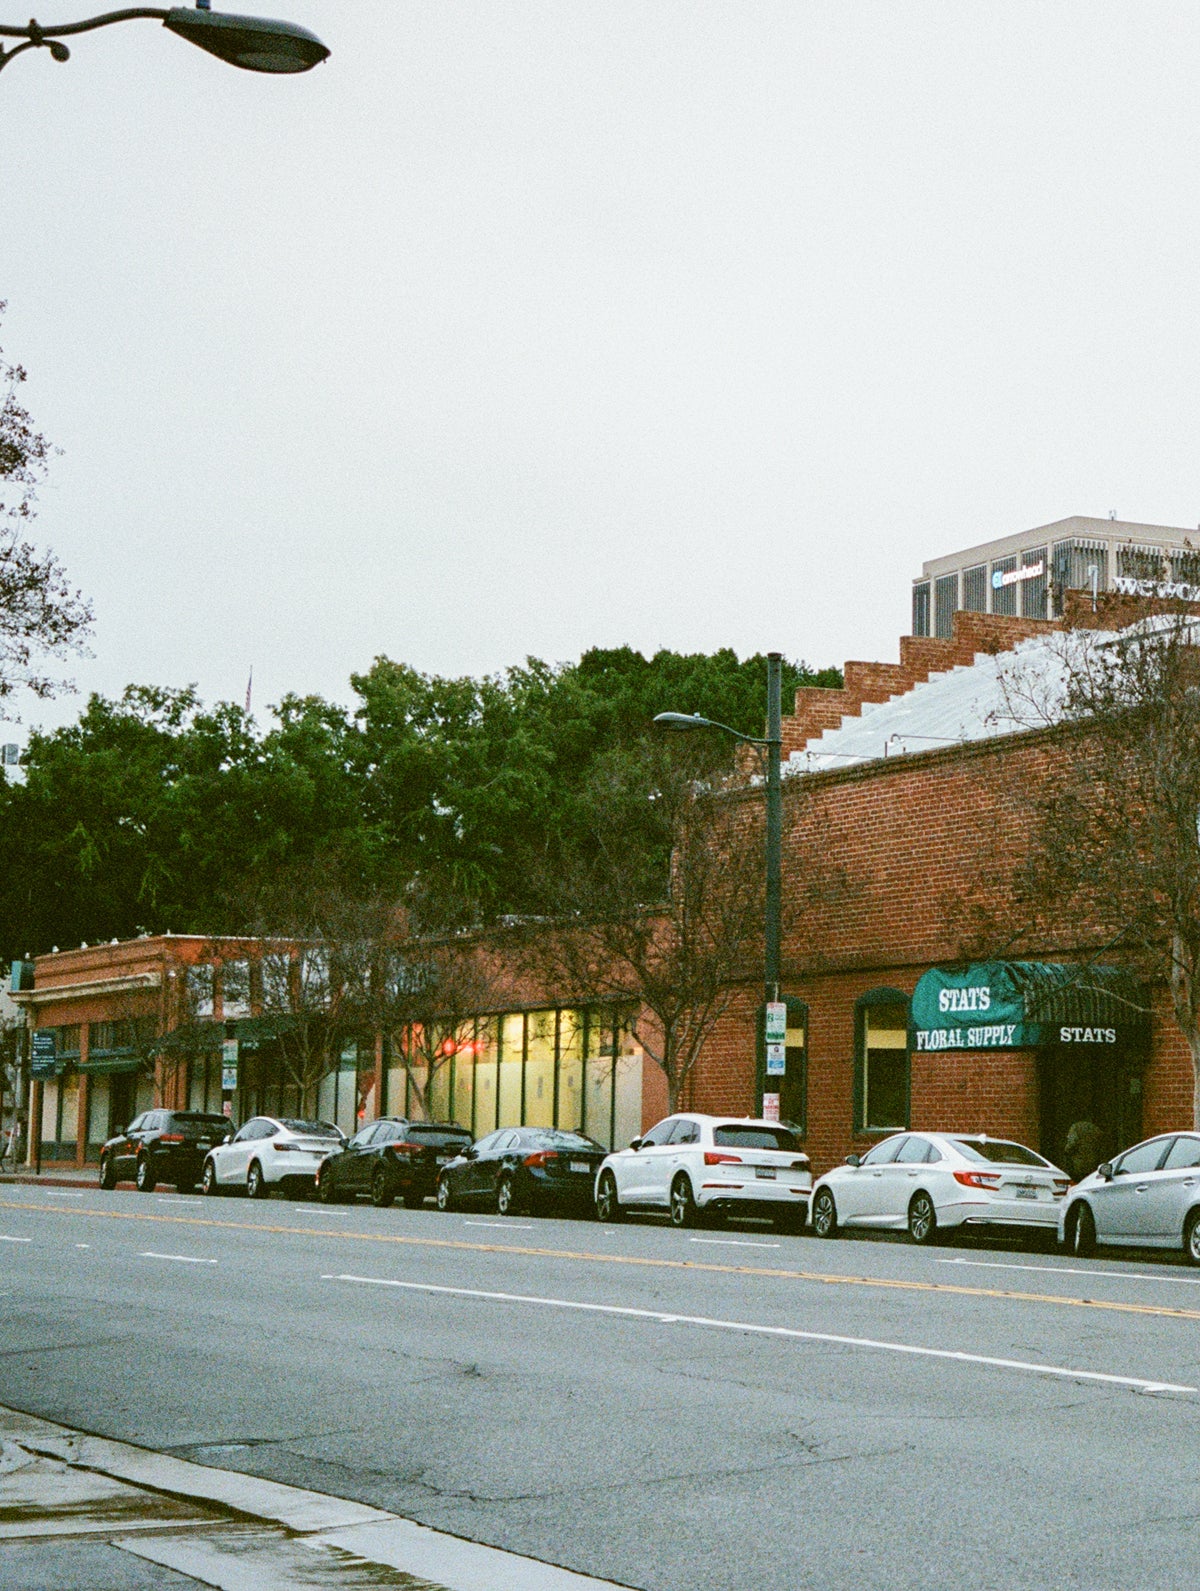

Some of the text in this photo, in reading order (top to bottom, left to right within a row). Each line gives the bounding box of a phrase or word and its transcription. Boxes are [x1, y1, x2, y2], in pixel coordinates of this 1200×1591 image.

[916, 1025, 1016, 1050] FLORAL SUPPLY
[1060, 1026, 1117, 1043] STATS
